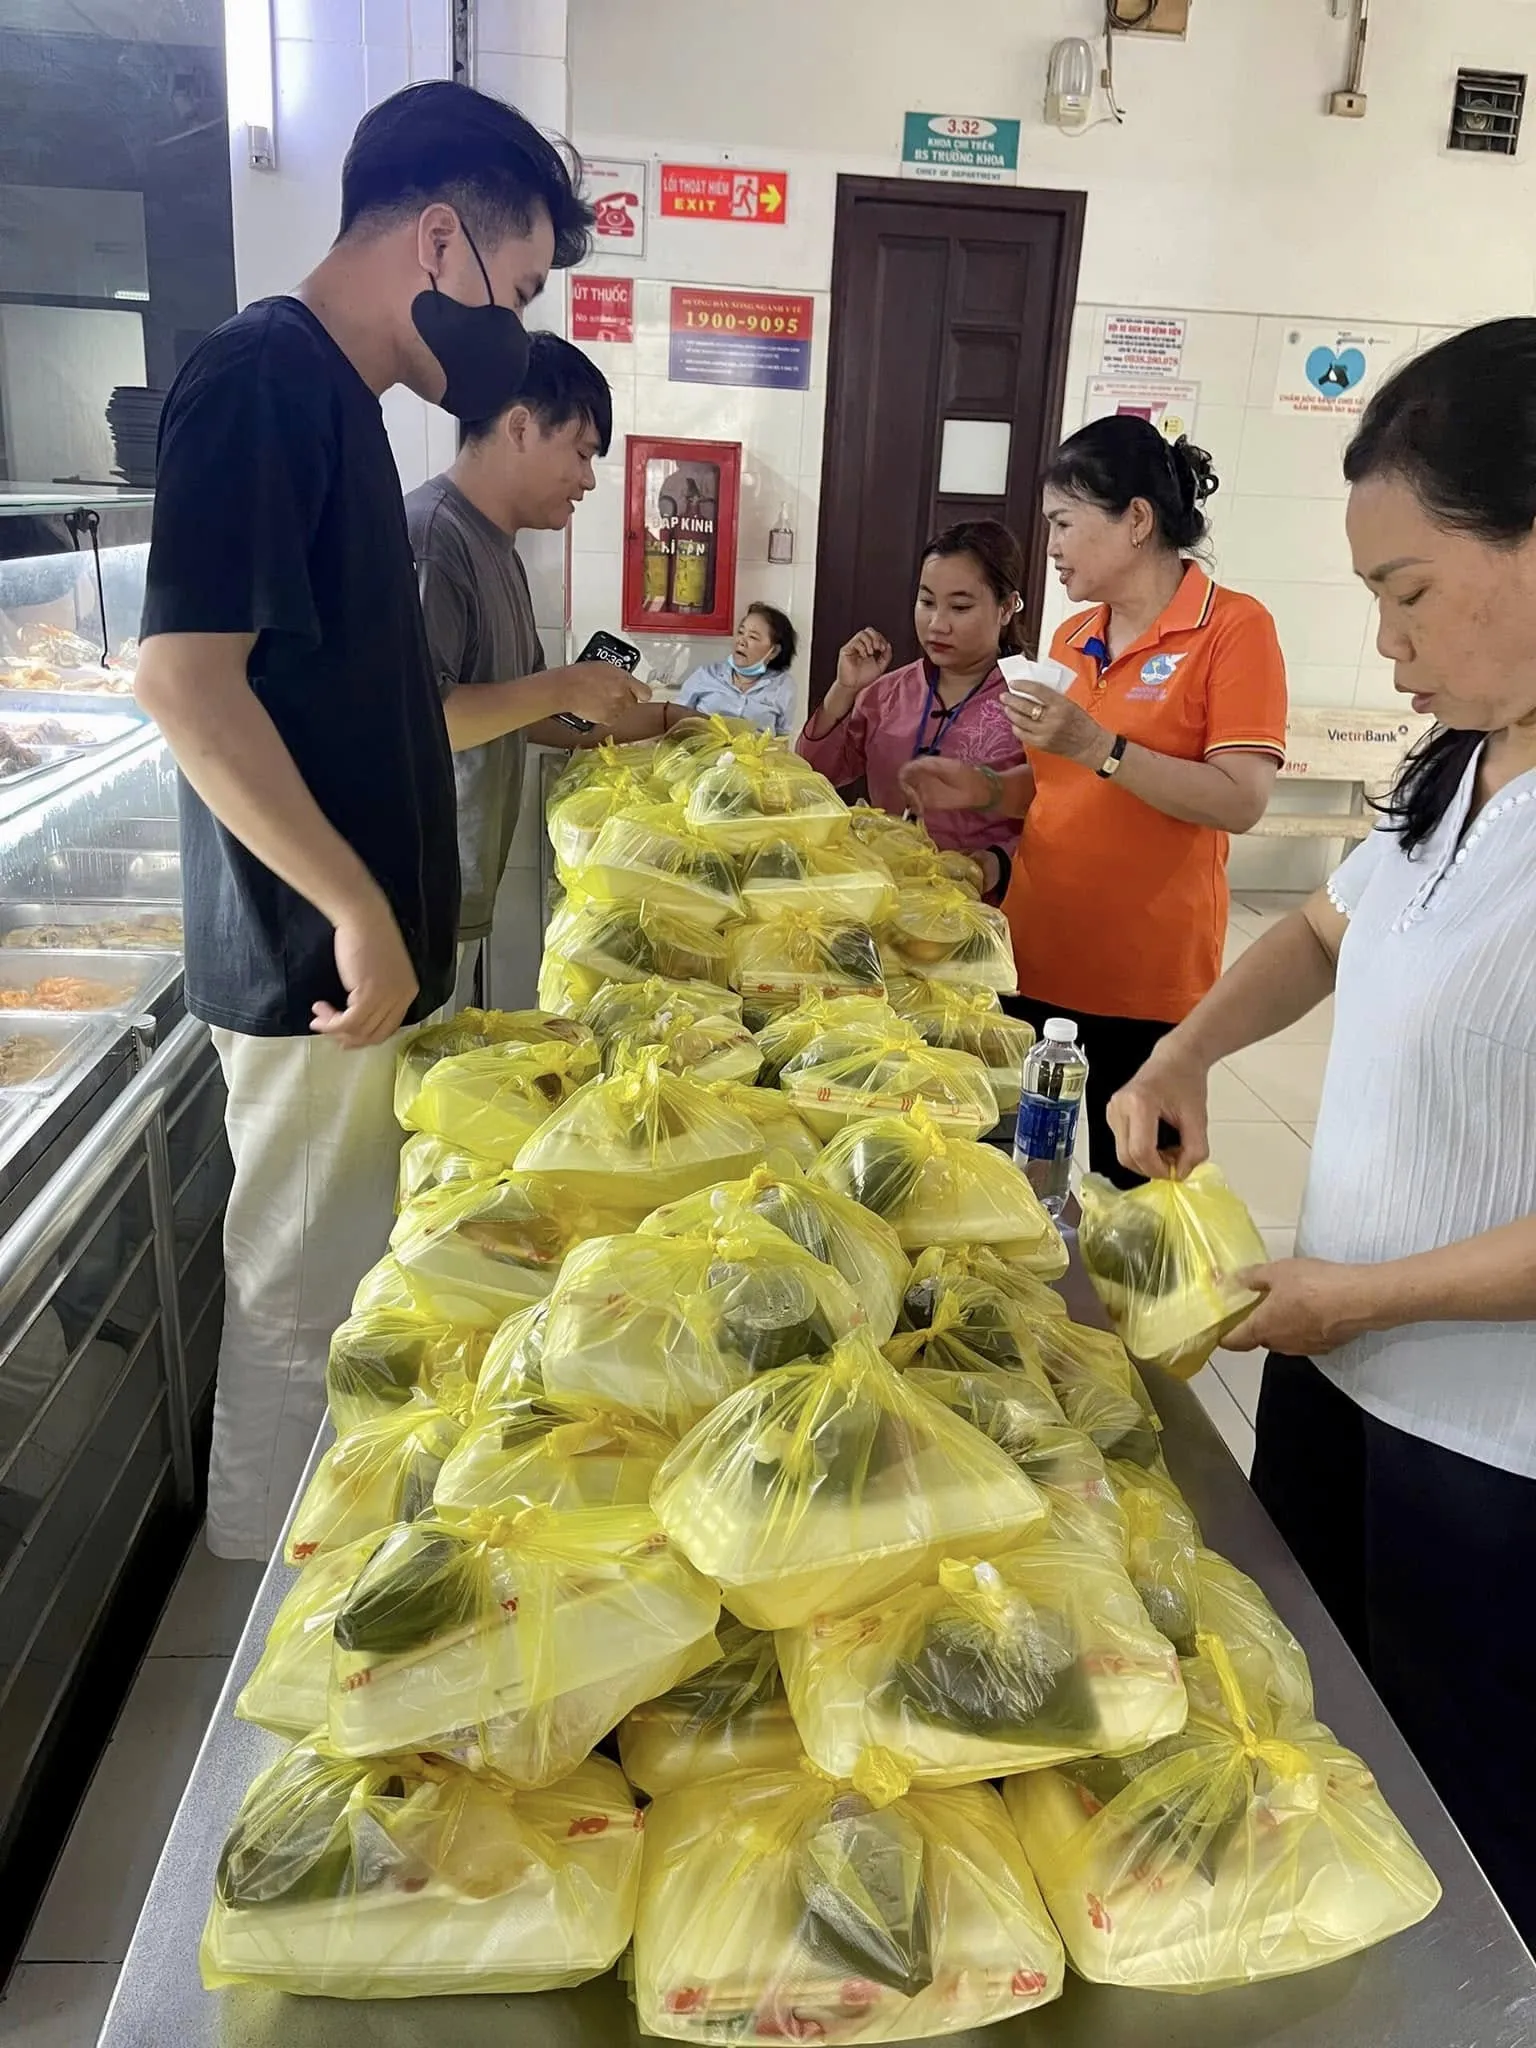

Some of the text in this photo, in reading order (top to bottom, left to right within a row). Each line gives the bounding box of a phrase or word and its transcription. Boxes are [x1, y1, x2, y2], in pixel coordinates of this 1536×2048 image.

[947, 119, 980, 135] 3.32
[976, 154, 1005, 167] KHOA
[674, 197, 716, 212] EXIT
[573, 283, 628, 303] ÚT THUỐC
[685, 311, 799, 334] 1900-9095
[681, 514, 713, 533] KÍNH
[1328, 728, 1397, 742] VietinBank
